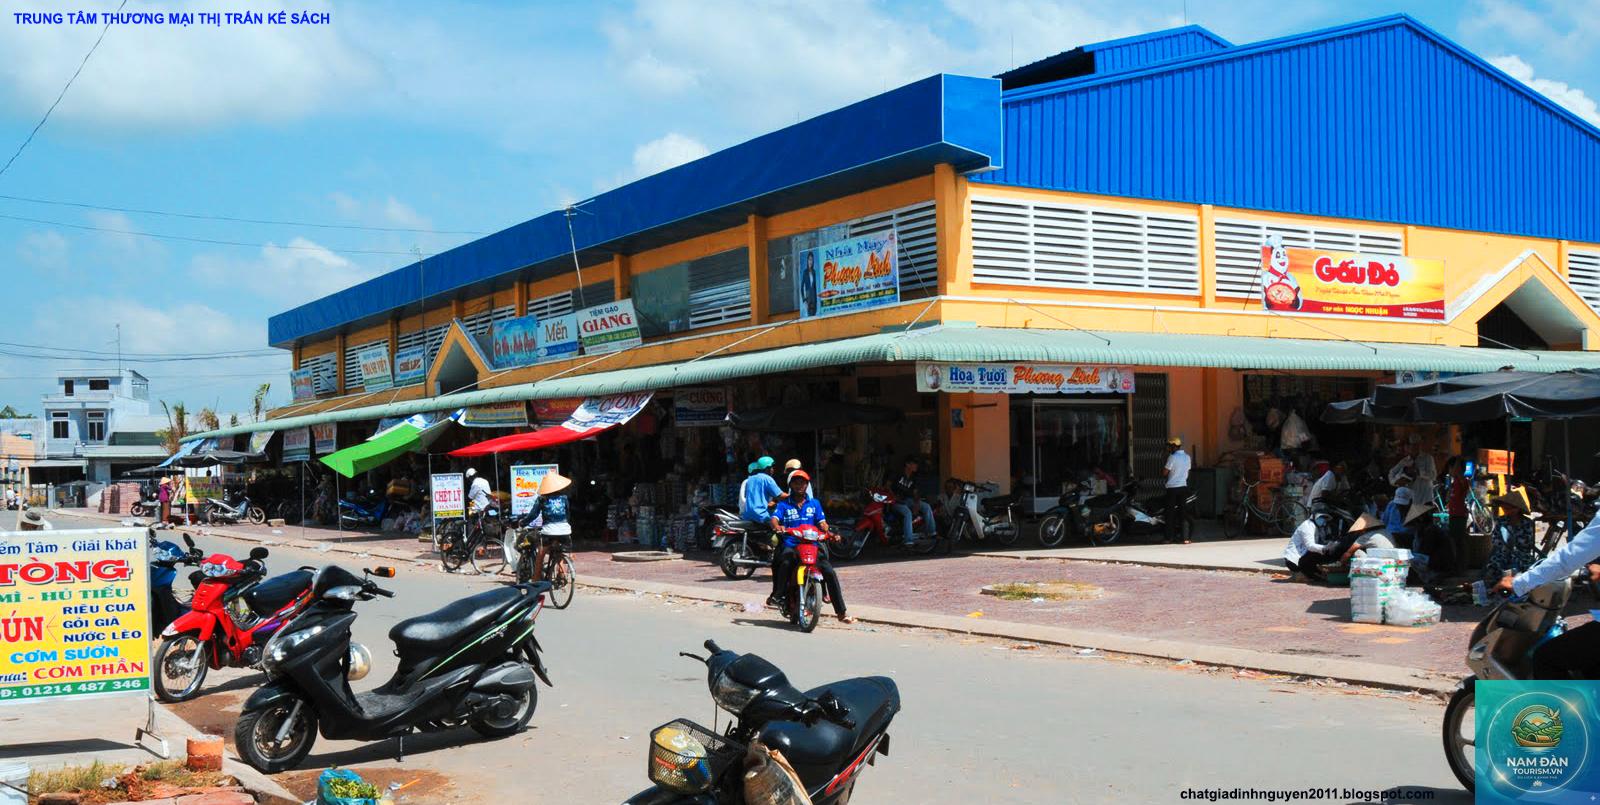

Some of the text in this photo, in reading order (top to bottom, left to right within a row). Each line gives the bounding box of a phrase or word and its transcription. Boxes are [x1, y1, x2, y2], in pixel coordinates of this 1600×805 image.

[863, 250, 892, 279] Linh
[1315, 257, 1400, 287] Gấu Đỏ
[582, 312, 632, 333] GIANG
[949, 366, 1008, 385] Hoa Tươi
[1067, 366, 1101, 386] Linh
[25, 541, 58, 555] Tâm
[106, 538, 137, 551] Khát
[79, 584, 129, 600] TIẾU
[63, 603, 136, 615] RIÊU CUA
[0, 610, 44, 643] ÚN
[64, 630, 142, 643] NƯỚC LÈO
[10, 645, 119, 664] CƠM SƯỜN
[34, 666, 83, 680] CƠM
[91, 658, 144, 677] PHẦN
[0, 679, 142, 698] Đ: 01214 487 346
